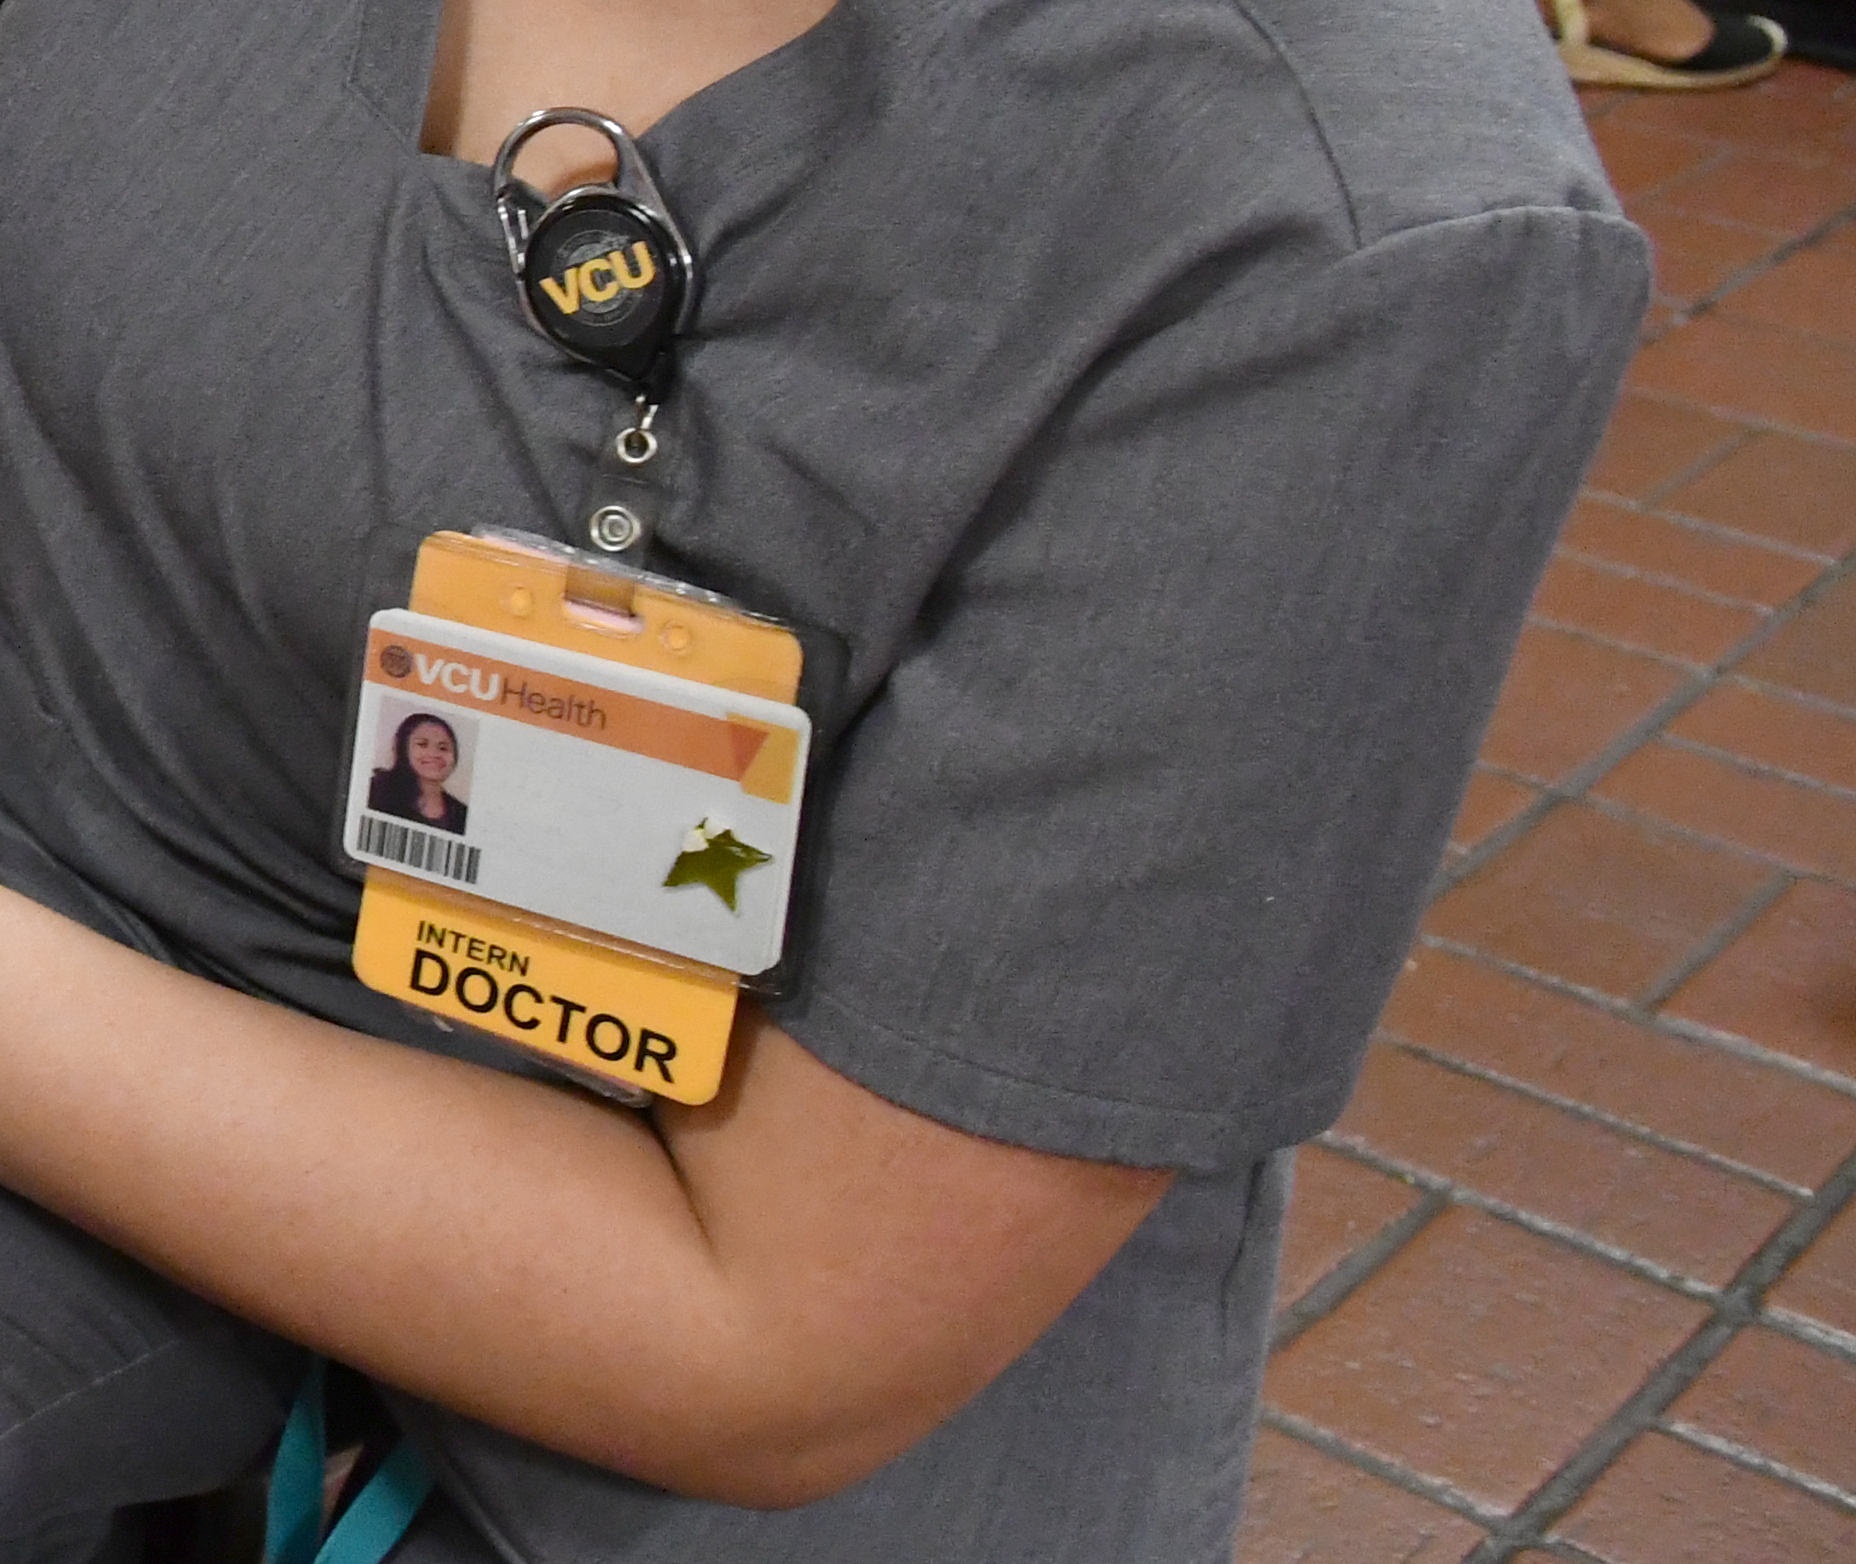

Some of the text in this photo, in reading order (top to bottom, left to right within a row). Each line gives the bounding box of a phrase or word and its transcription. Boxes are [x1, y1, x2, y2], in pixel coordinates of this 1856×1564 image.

[539, 241, 656, 314] VCU
[417, 920, 530, 976] INTERN
[409, 948, 678, 1084] DOCTOR
